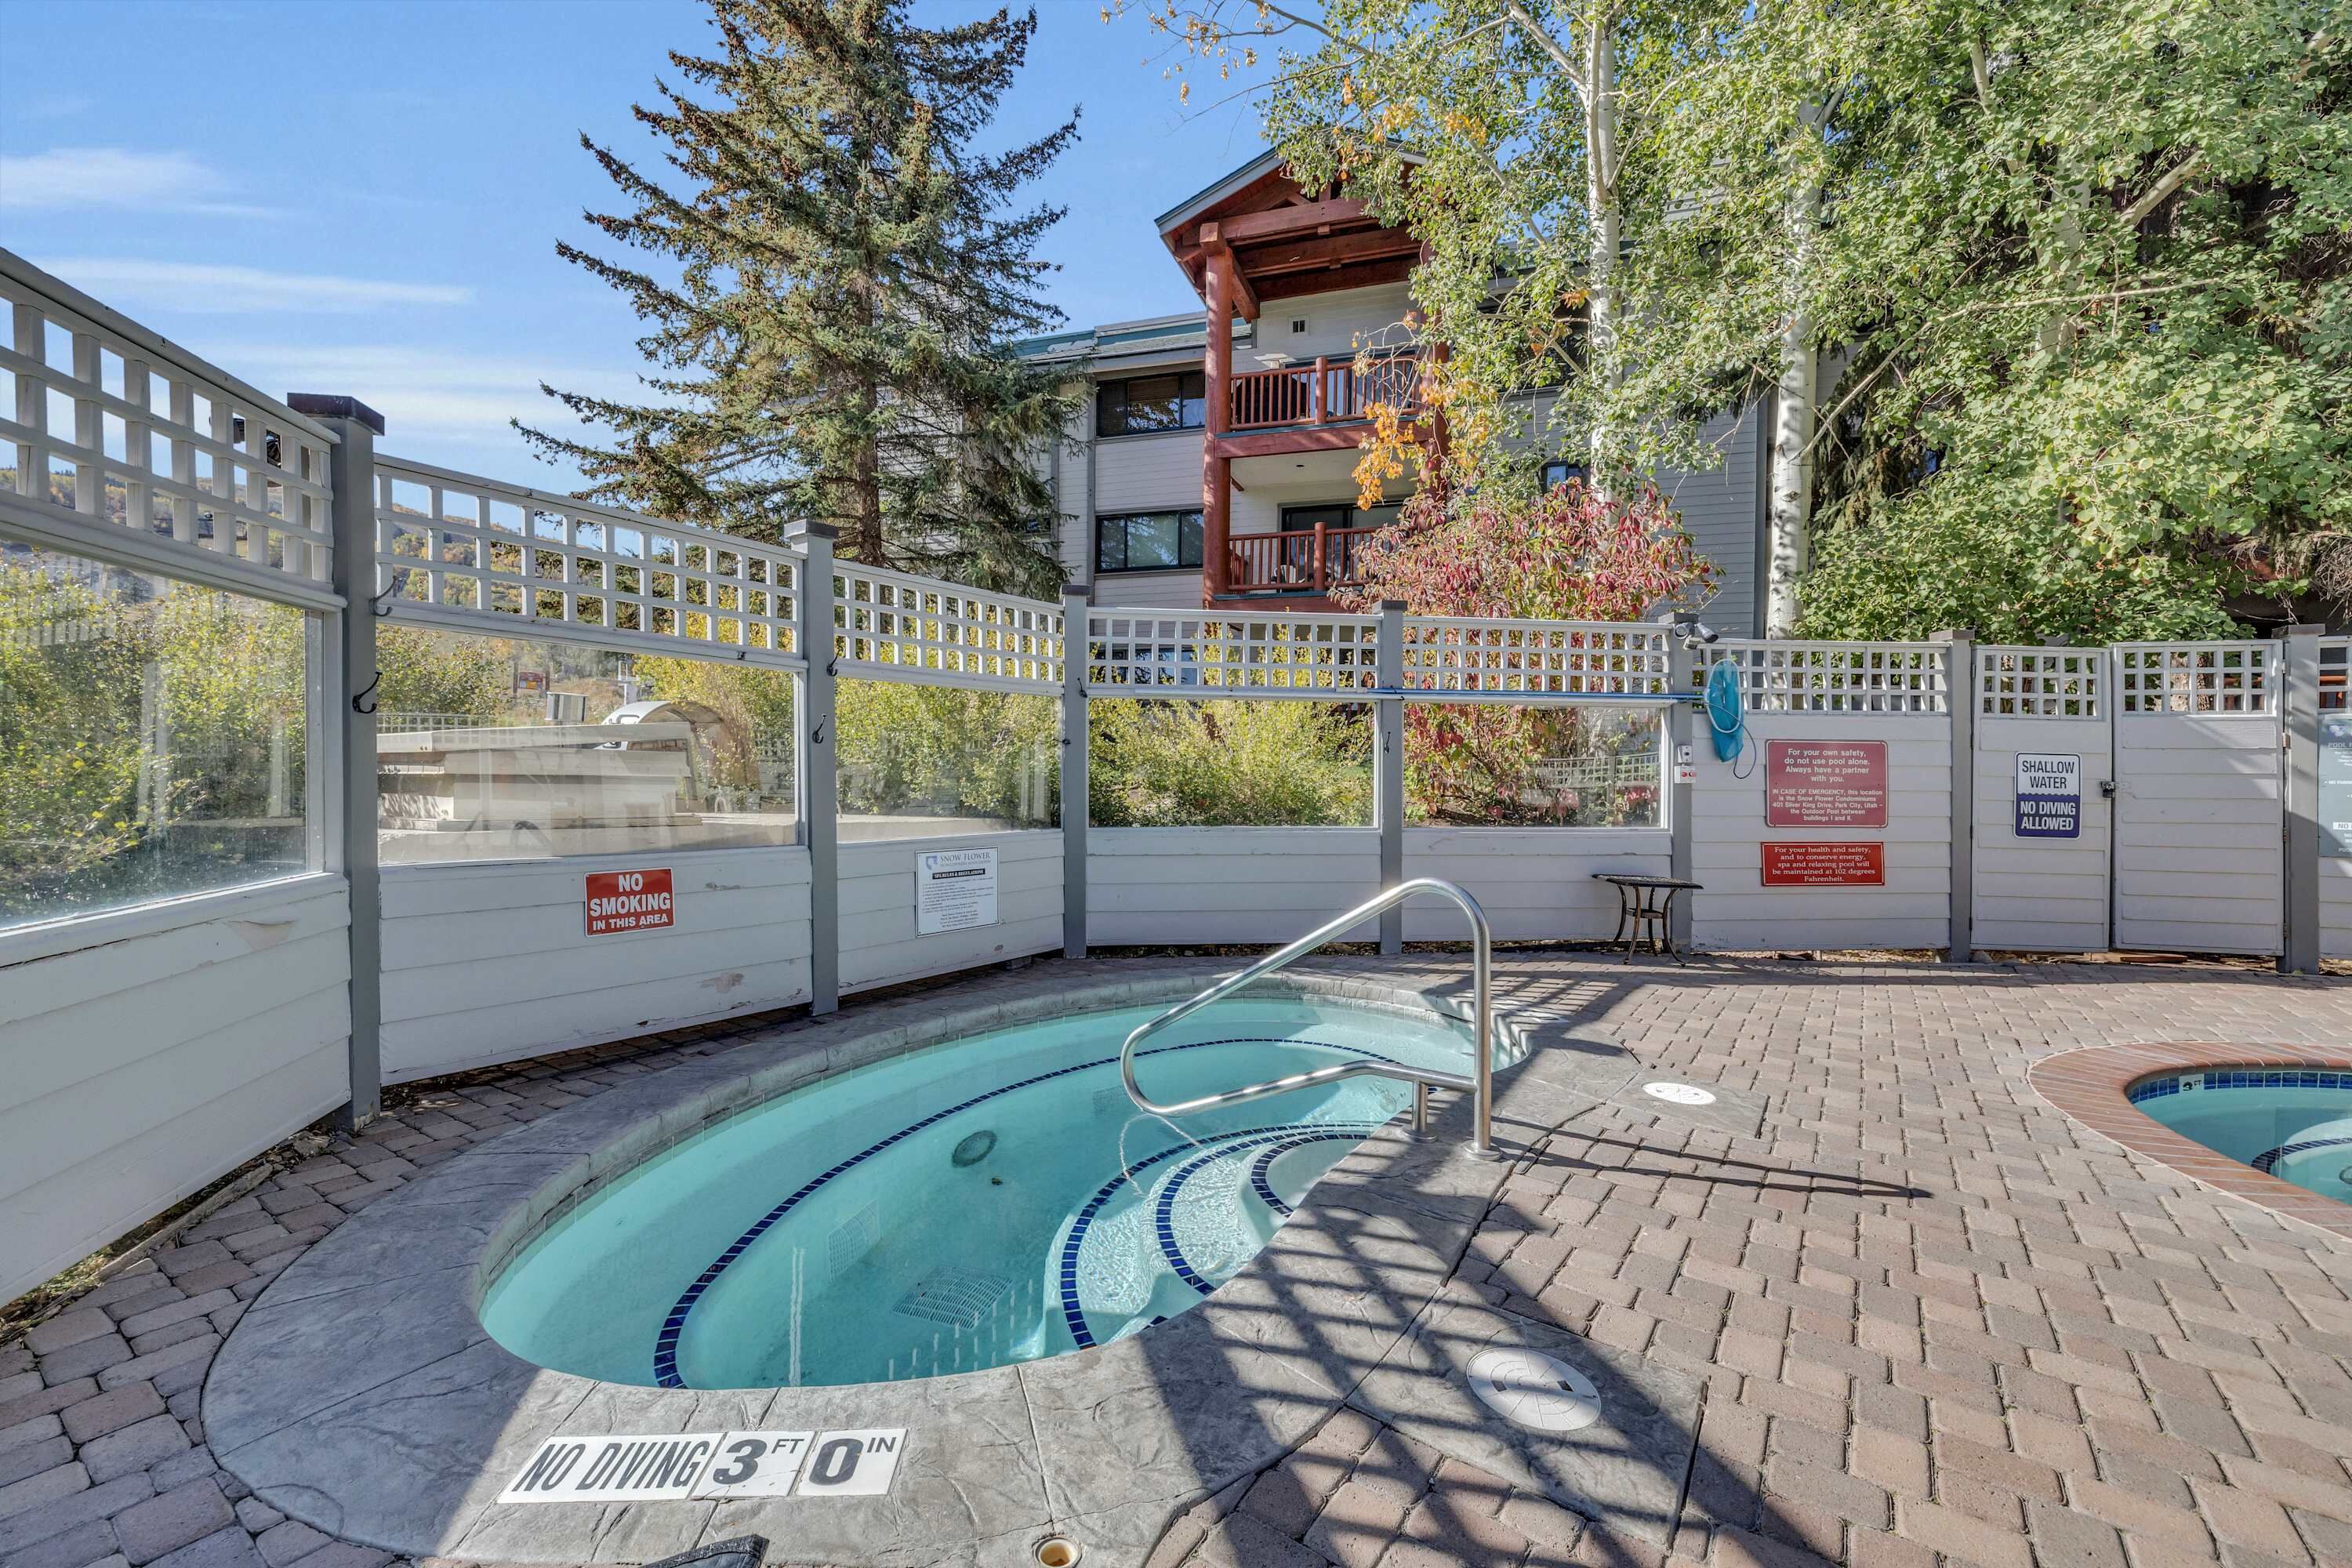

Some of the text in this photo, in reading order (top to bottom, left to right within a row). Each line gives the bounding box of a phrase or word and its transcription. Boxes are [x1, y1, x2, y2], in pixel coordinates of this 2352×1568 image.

[1841, 749, 1866, 757] safety,
[2022, 760, 2075, 773] SHALLOW
[2030, 776, 2067, 789] WATER
[2020, 801, 2076, 815] NO DIVING
[2021, 817, 2074, 830] ALLOWED
[618, 873, 643, 892] NO
[590, 892, 670, 917] SMOKING
[593, 914, 668, 930] IN THIS AREA
[511, 1441, 710, 1491] NO DIVING
[713, 1439, 804, 1485] 3 FT
[809, 1437, 897, 1486] 0 IN
